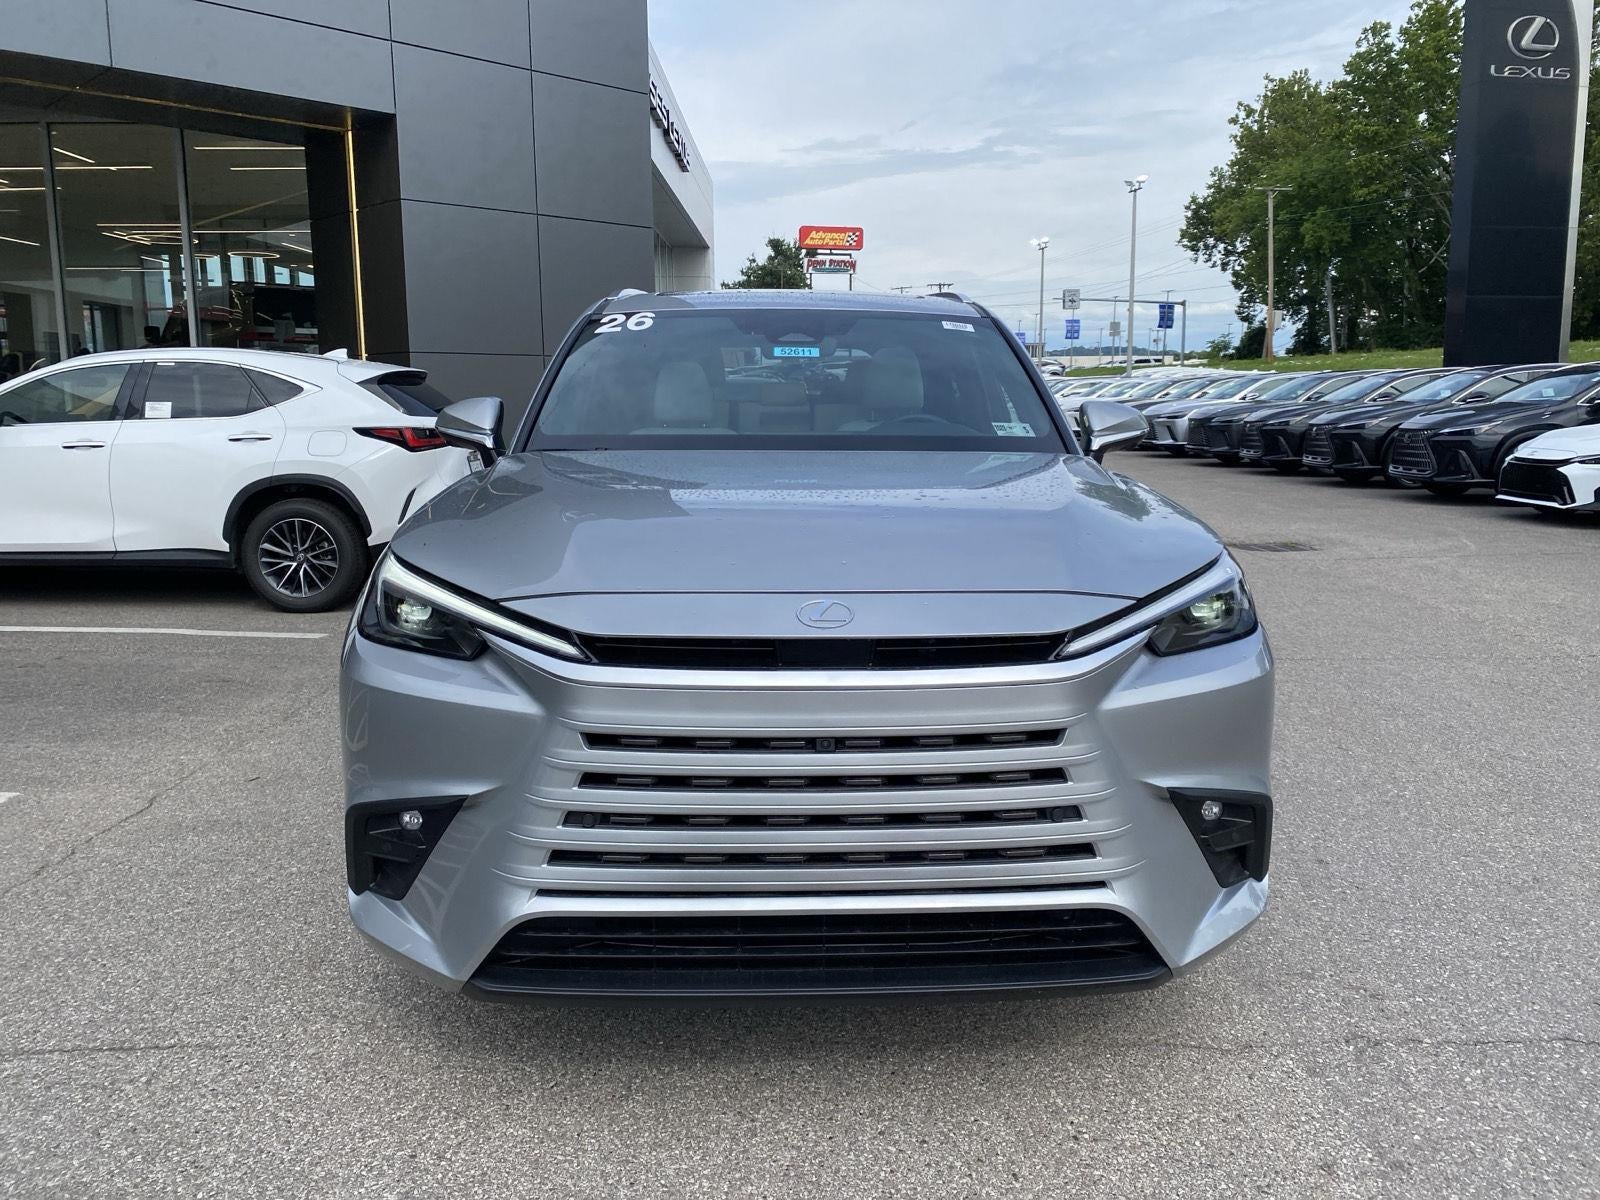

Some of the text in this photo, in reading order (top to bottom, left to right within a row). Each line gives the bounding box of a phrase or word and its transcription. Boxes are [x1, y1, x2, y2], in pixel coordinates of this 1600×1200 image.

[1490, 64, 1571, 79] LEXUS
[809, 230, 846, 239] Advance
[823, 238, 843, 246] Parts
[594, 312, 656, 333] 26
